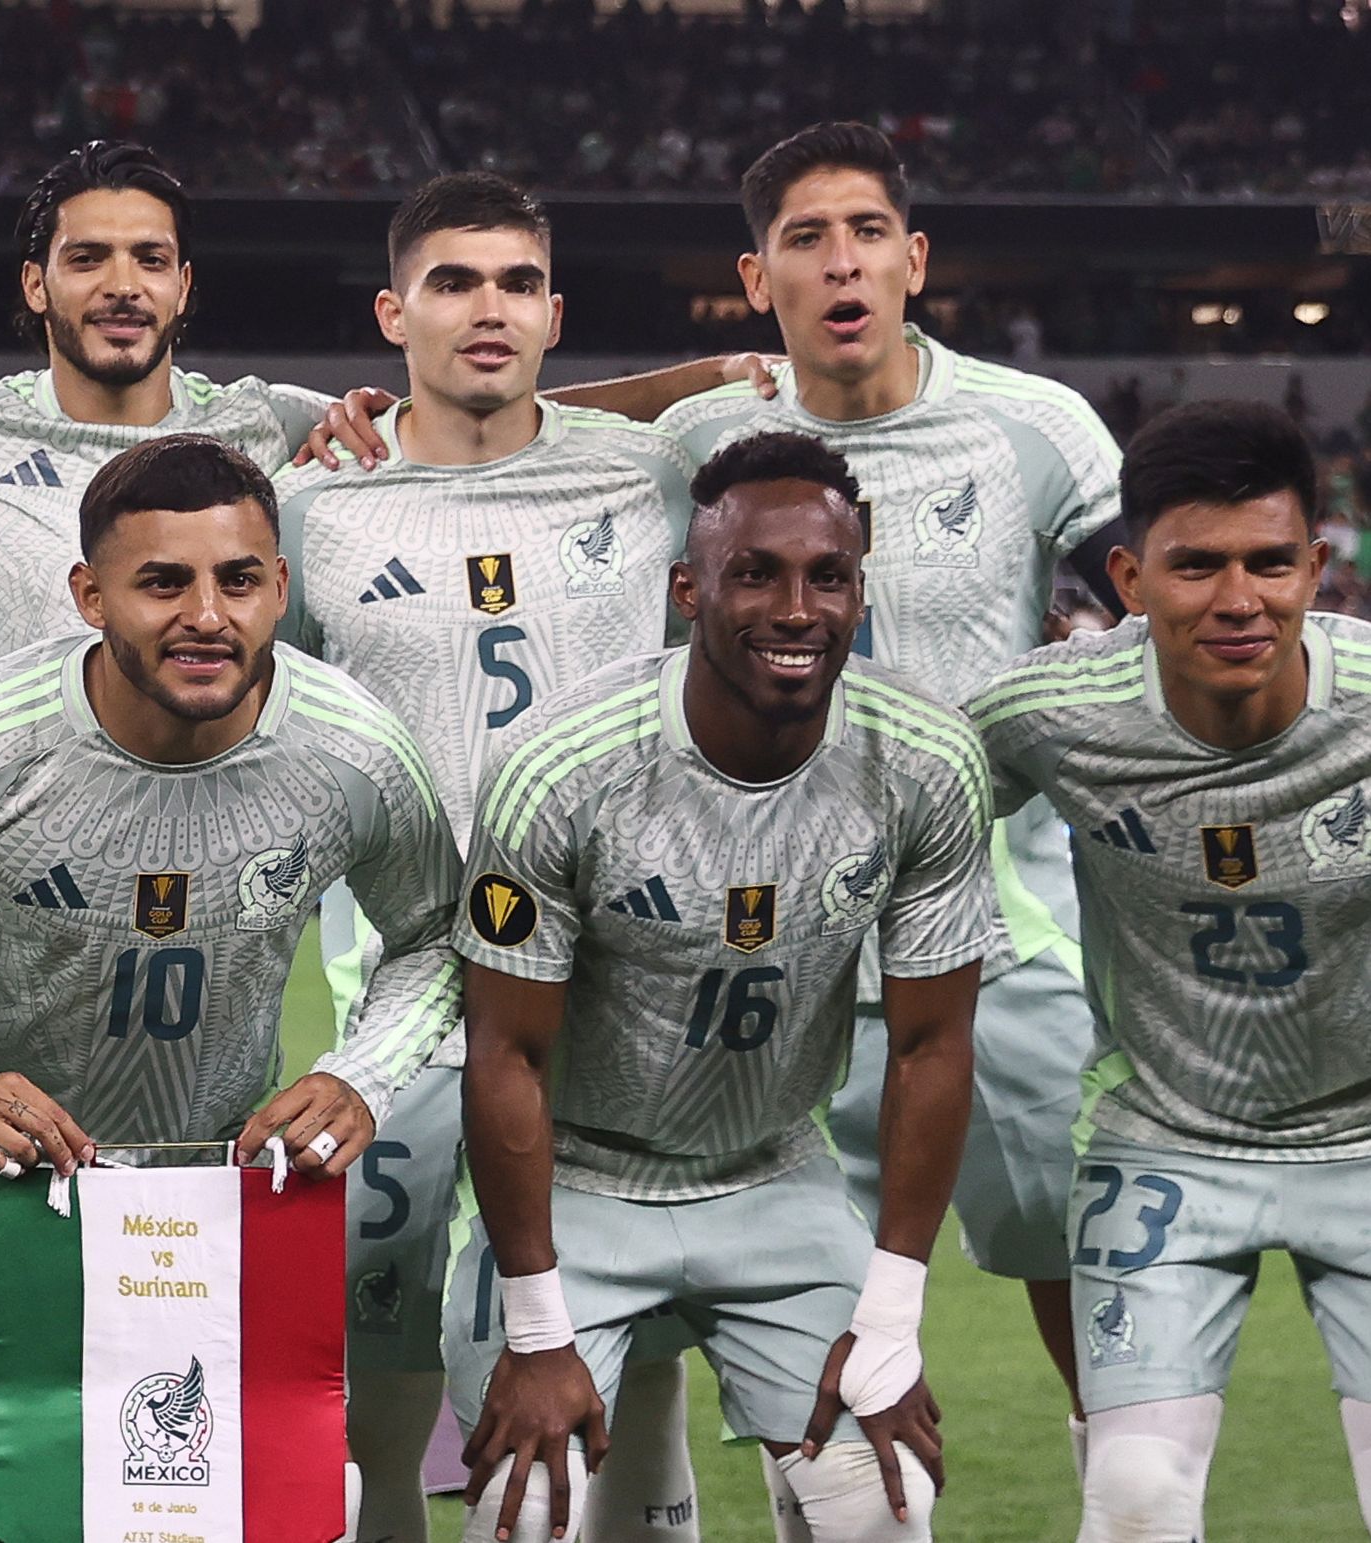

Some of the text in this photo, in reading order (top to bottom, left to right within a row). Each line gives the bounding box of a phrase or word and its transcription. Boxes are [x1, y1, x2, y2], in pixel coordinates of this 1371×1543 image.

[570, 581, 622, 594] MÉXICO
[478, 624, 533, 729] 5
[1180, 901, 1308, 987] 23
[108, 948, 205, 1040] 10
[684, 965, 785, 1053] 16
[360, 1141, 412, 1240] 5
[1072, 1165, 1183, 1268] 23
[122, 1214, 198, 1237] México
[118, 1275, 208, 1298] Surinam
[151, 1251, 174, 1268] vs
[128, 1462, 205, 1481] MÉXICO
[148, 1501, 163, 1513] de
